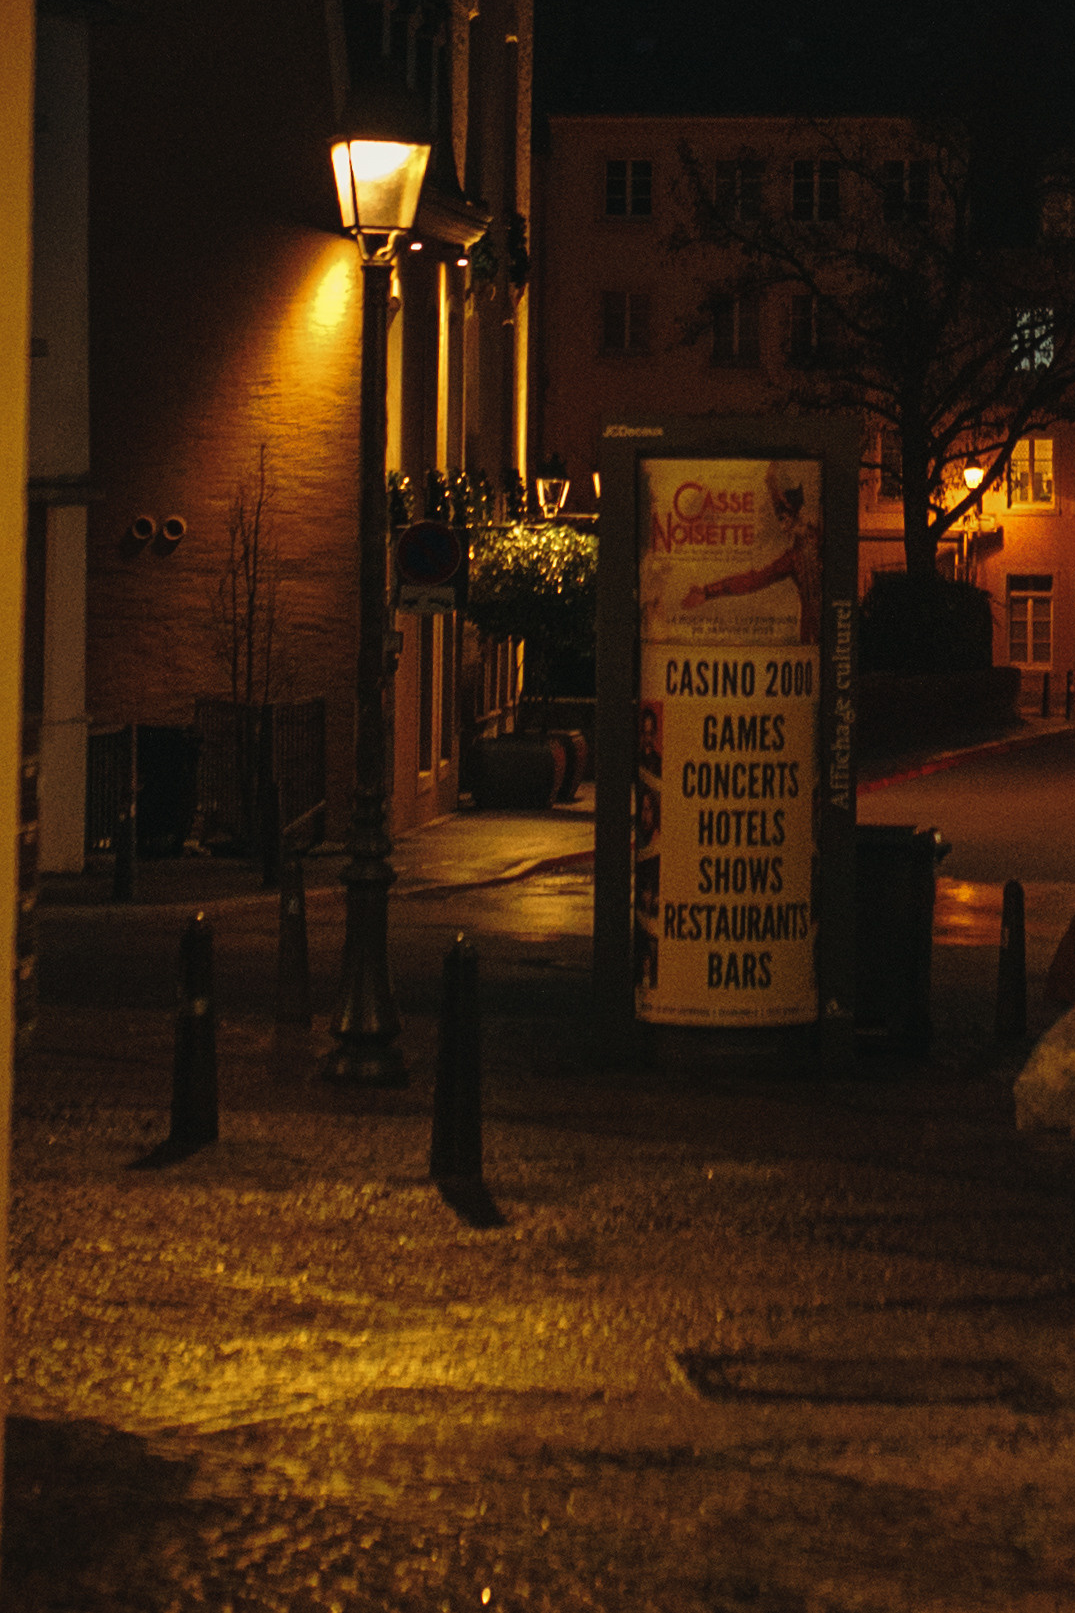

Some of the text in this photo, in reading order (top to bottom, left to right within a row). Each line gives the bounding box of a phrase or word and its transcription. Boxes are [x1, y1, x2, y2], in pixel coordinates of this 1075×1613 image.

[674, 481, 755, 523] CASSE
[652, 511, 755, 553] NOISETTE
[666, 659, 813, 698] CASINO 2000
[830, 599, 855, 811] Affichage culturel
[702, 714, 786, 752] GAMES
[682, 761, 799, 799] CONCERTS
[698, 809, 785, 847] HOTELS
[698, 856, 783, 894] SHOWS
[664, 902, 809, 941] RESTAURANTS
[707, 951, 773, 990] BARS
